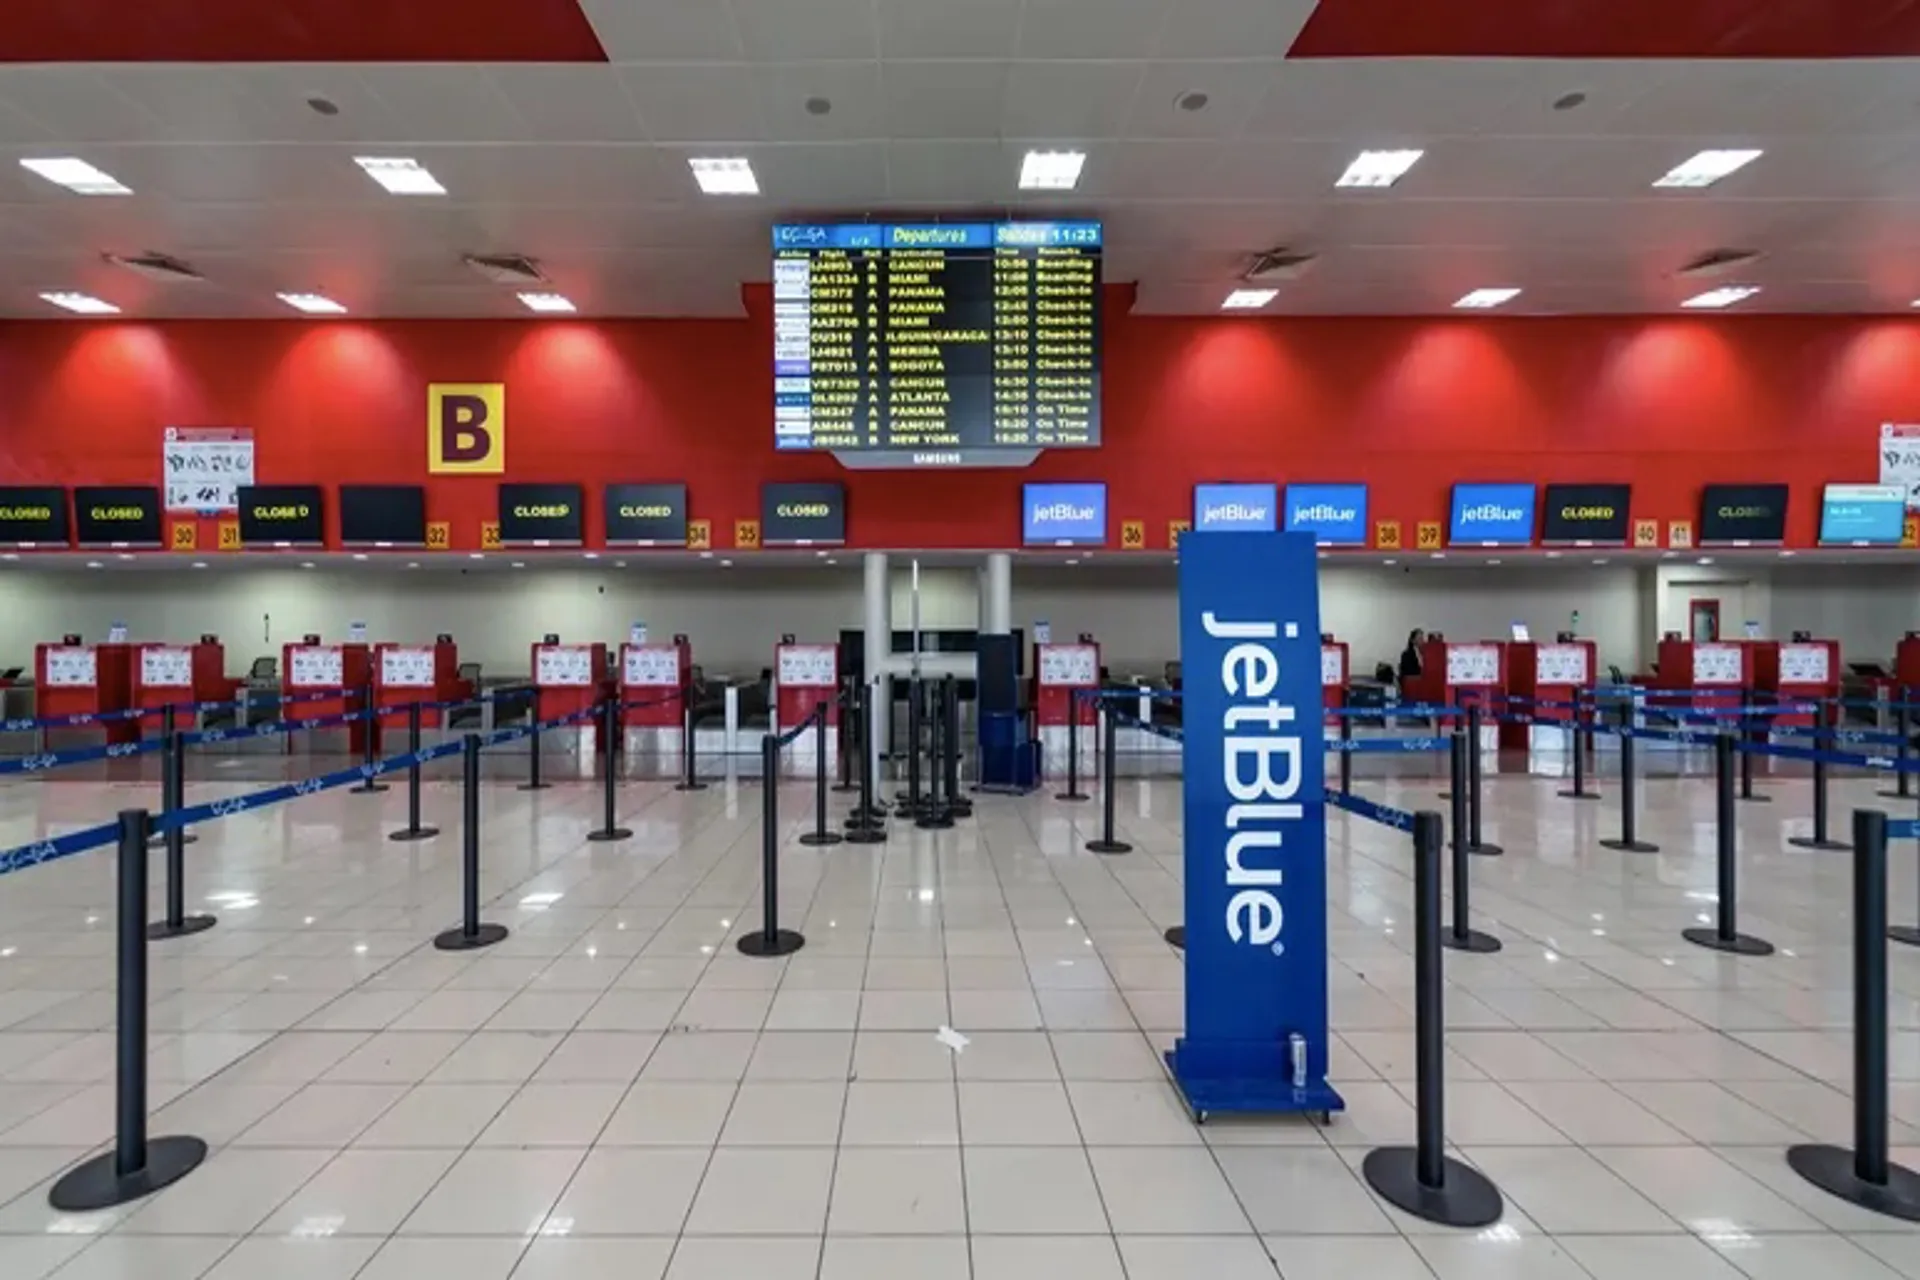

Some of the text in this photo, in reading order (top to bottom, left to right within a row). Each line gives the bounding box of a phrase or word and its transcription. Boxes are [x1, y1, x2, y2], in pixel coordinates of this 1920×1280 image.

[893, 227, 967, 243] Departures
[1051, 229, 1097, 241] 11:23
[868, 260, 877, 271] A
[889, 259, 944, 271] CANCUN
[1036, 258, 1093, 270] Boarding
[1036, 272, 1093, 283] Boarding
[868, 287, 877, 298] A
[889, 286, 944, 298] PANAMA
[1036, 285, 1092, 296] Check-In
[868, 302, 877, 313] A
[889, 302, 944, 313] PANAMA
[1036, 301, 1092, 312] Check-In
[1036, 315, 1092, 326] Check-In
[868, 331, 877, 343] A
[1036, 330, 1092, 340] Check-In
[868, 346, 877, 357] A
[889, 345, 939, 357] MERIDA
[1036, 344, 1092, 355] Check-In
[868, 361, 877, 372] A
[889, 360, 944, 371] BOGOTA
[1036, 359, 1092, 370] Check-In
[868, 377, 877, 389] A
[889, 377, 945, 388] CANCUN
[1036, 376, 1092, 387] Check-In
[868, 391, 877, 403] A
[889, 391, 951, 402] ATLANTA
[1036, 390, 1092, 401] Check-In
[868, 405, 877, 417] A
[889, 405, 945, 416] PANAMA
[1036, 404, 1053, 415] On
[1058, 404, 1088, 415] Time
[441, 394, 491, 463] B
[889, 420, 945, 431] CANCUN
[1036, 418, 1053, 429] On
[1058, 418, 1088, 429] Time
[890, 433, 919, 444] NEW
[923, 433, 959, 444] YORK
[1036, 432, 1053, 443] On
[1058, 432, 1088, 443] Time
[0, 507, 50, 520] CLOSED
[91, 507, 144, 520] CLOSED
[620, 505, 671, 518] CLOSED
[776, 504, 829, 518] CLOSED
[1033, 503, 1095, 523] jetBlue
[1203, 503, 1267, 524] jetBlue
[1294, 503, 1356, 524] jetBlue
[1461, 504, 1523, 523] jetBlue
[1561, 506, 1614, 520] CLOSED
[175, 527, 192, 543] 30
[223, 527, 237, 543] 31
[428, 527, 445, 543] 32
[689, 527, 706, 543] 34
[739, 526, 756, 543] 35
[1124, 527, 1141, 543] 36
[1380, 527, 1396, 543] 38
[1420, 527, 1437, 543] 39
[1638, 526, 1655, 541] 40
[1672, 526, 1687, 541] 41
[1202, 611, 1304, 947] jetBlue
